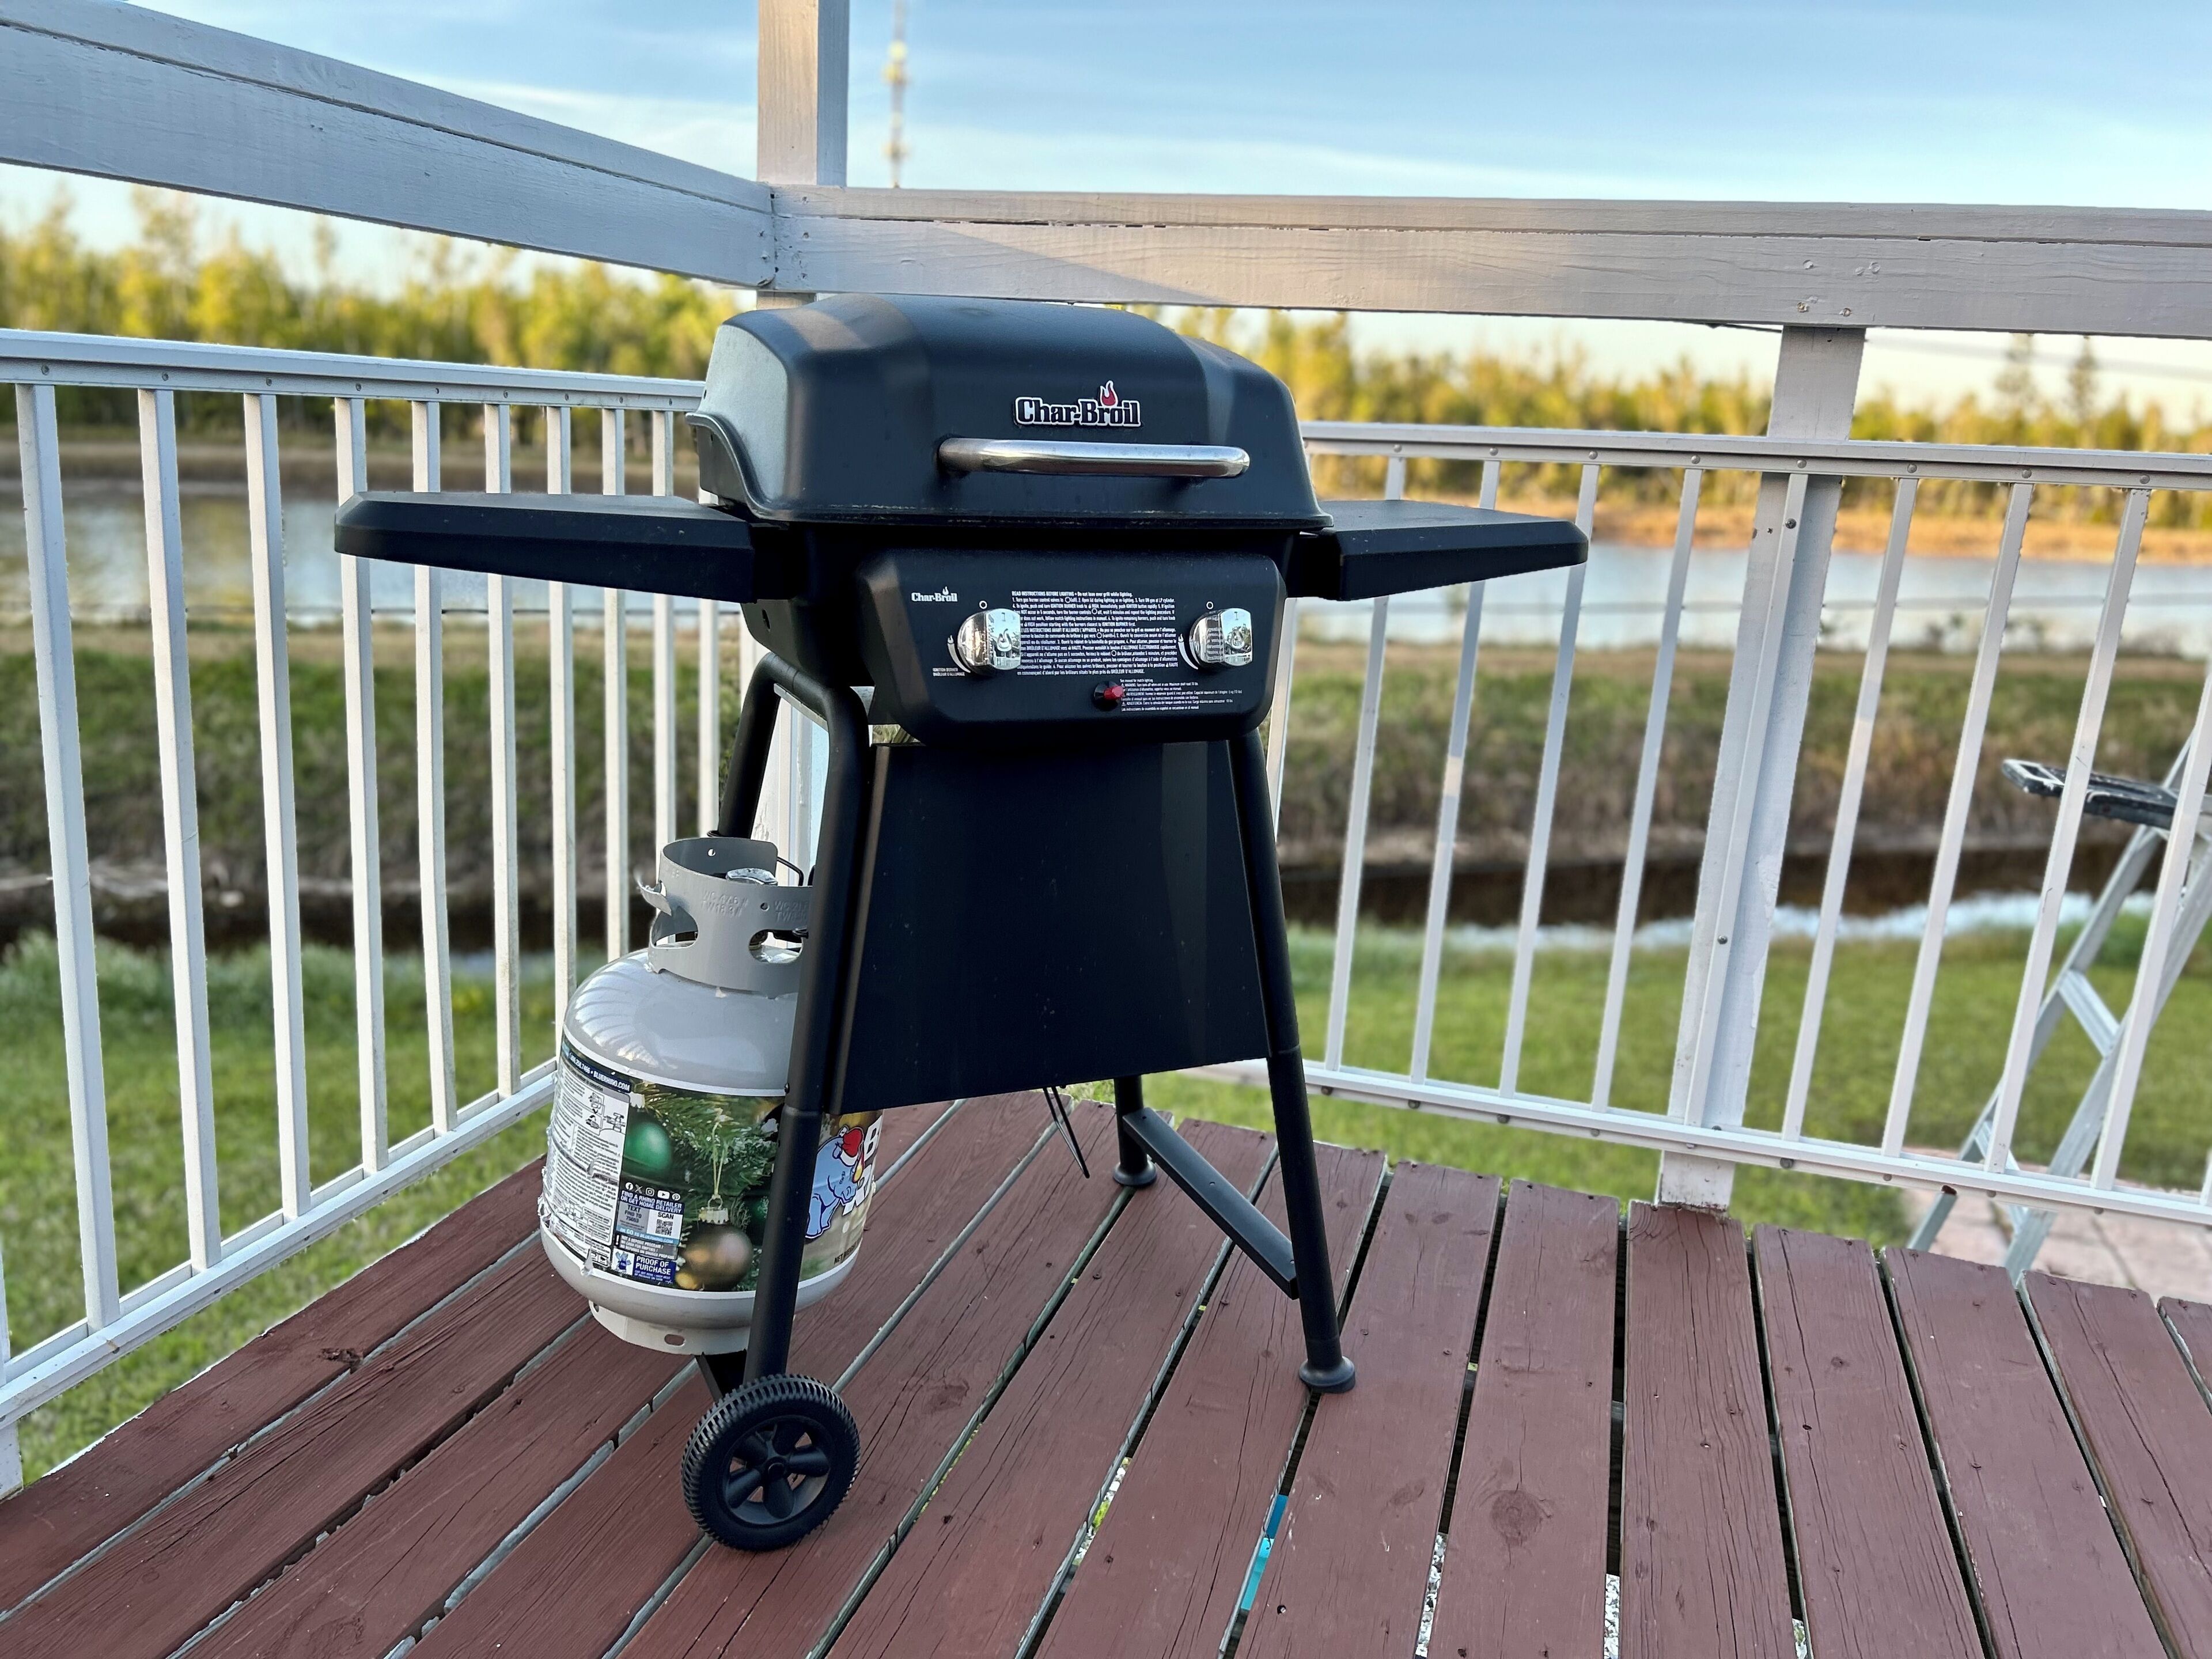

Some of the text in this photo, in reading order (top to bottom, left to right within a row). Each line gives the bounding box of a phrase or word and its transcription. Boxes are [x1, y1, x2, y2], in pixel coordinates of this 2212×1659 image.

[1016, 397, 1141, 427] Char-Broil
[911, 592, 957, 601] Char-Broil
[622, 1190, 633, 1198] FIND
[639, 1195, 656, 1204] RHINO
[656, 1199, 683, 1209] RETAILER
[628, 1205, 641, 1213] TEXT
[639, 1200, 655, 1209] HOME
[656, 1205, 682, 1213] DELIVERY
[658, 1211, 675, 1219] SCAN
[636, 1256, 659, 1266] PROOF
[635, 1263, 671, 1275] PURCHASE
